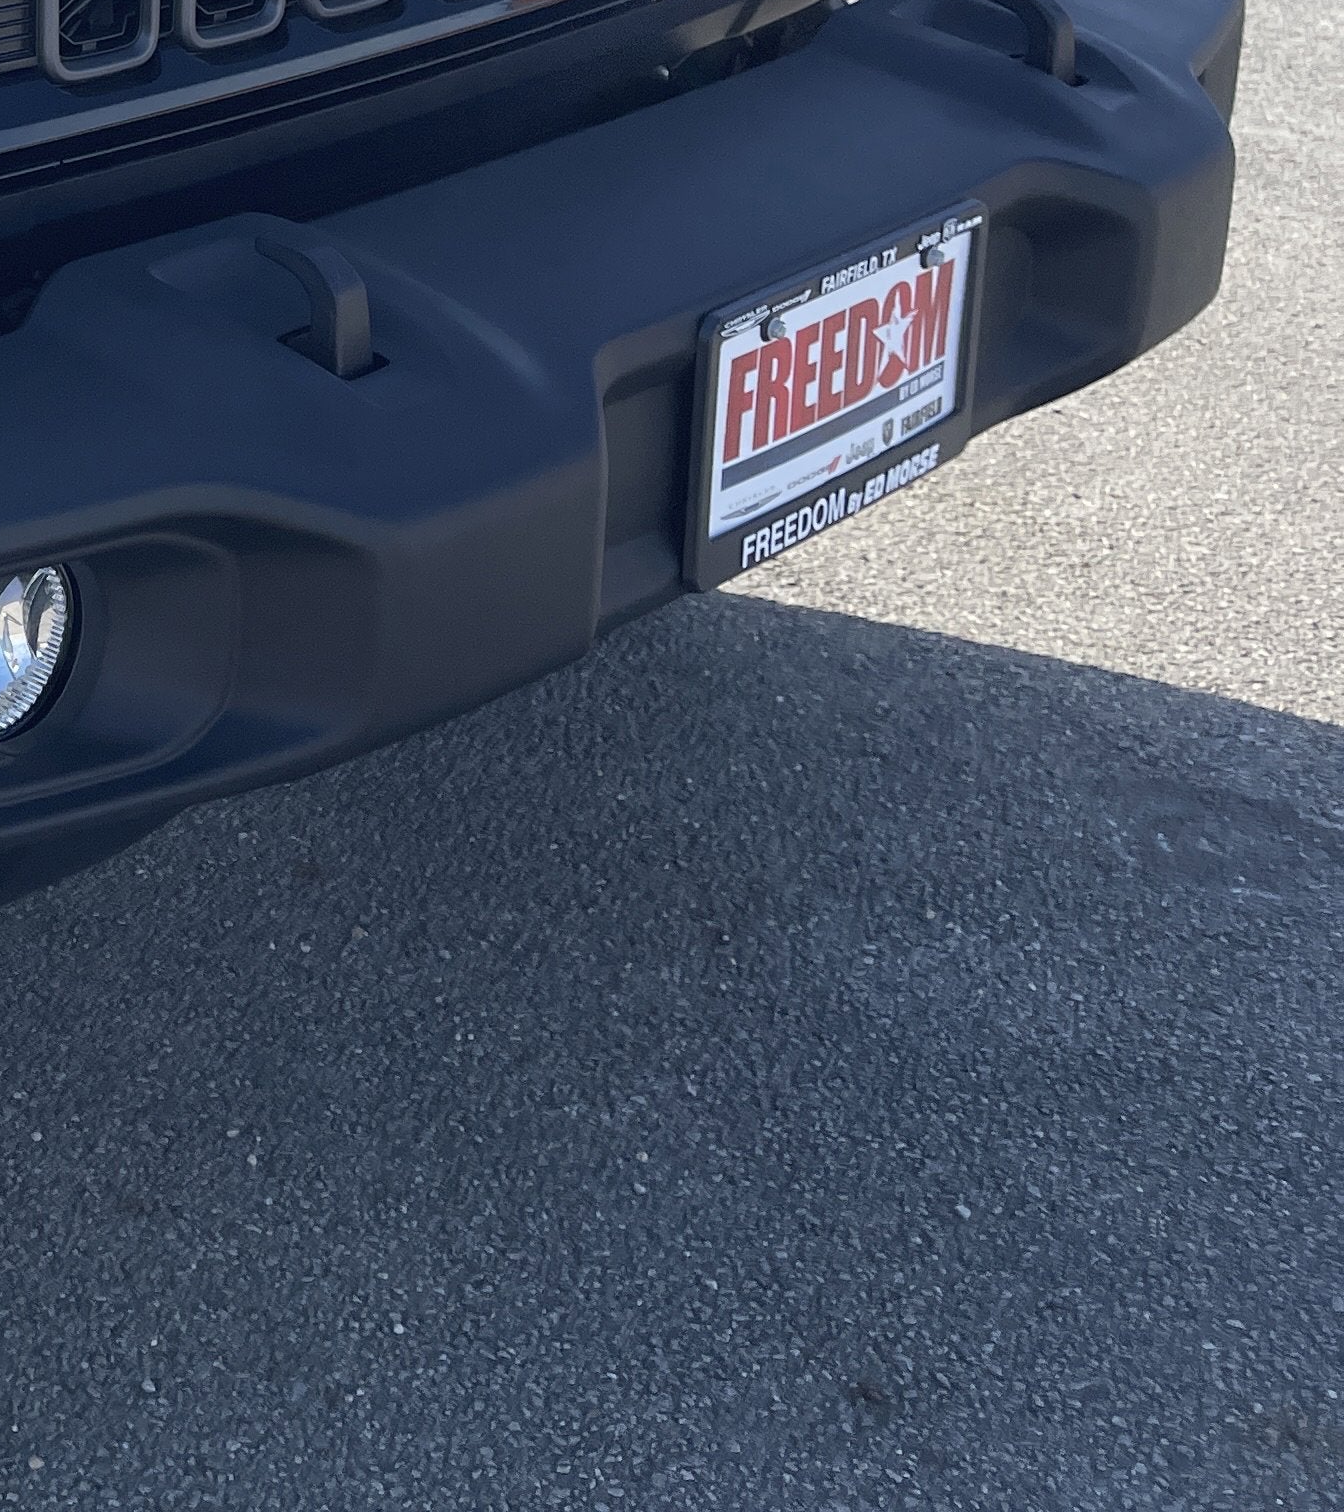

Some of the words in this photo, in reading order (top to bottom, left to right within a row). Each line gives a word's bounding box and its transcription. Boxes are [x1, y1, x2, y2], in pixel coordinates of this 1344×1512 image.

[882, 245, 898, 268] TX
[722, 257, 955, 465] FREEDOM
[845, 437, 875, 465] Jeep
[741, 487, 847, 569] FREEDOM
[864, 477, 885, 506] ED
[886, 443, 941, 494] MORSE
